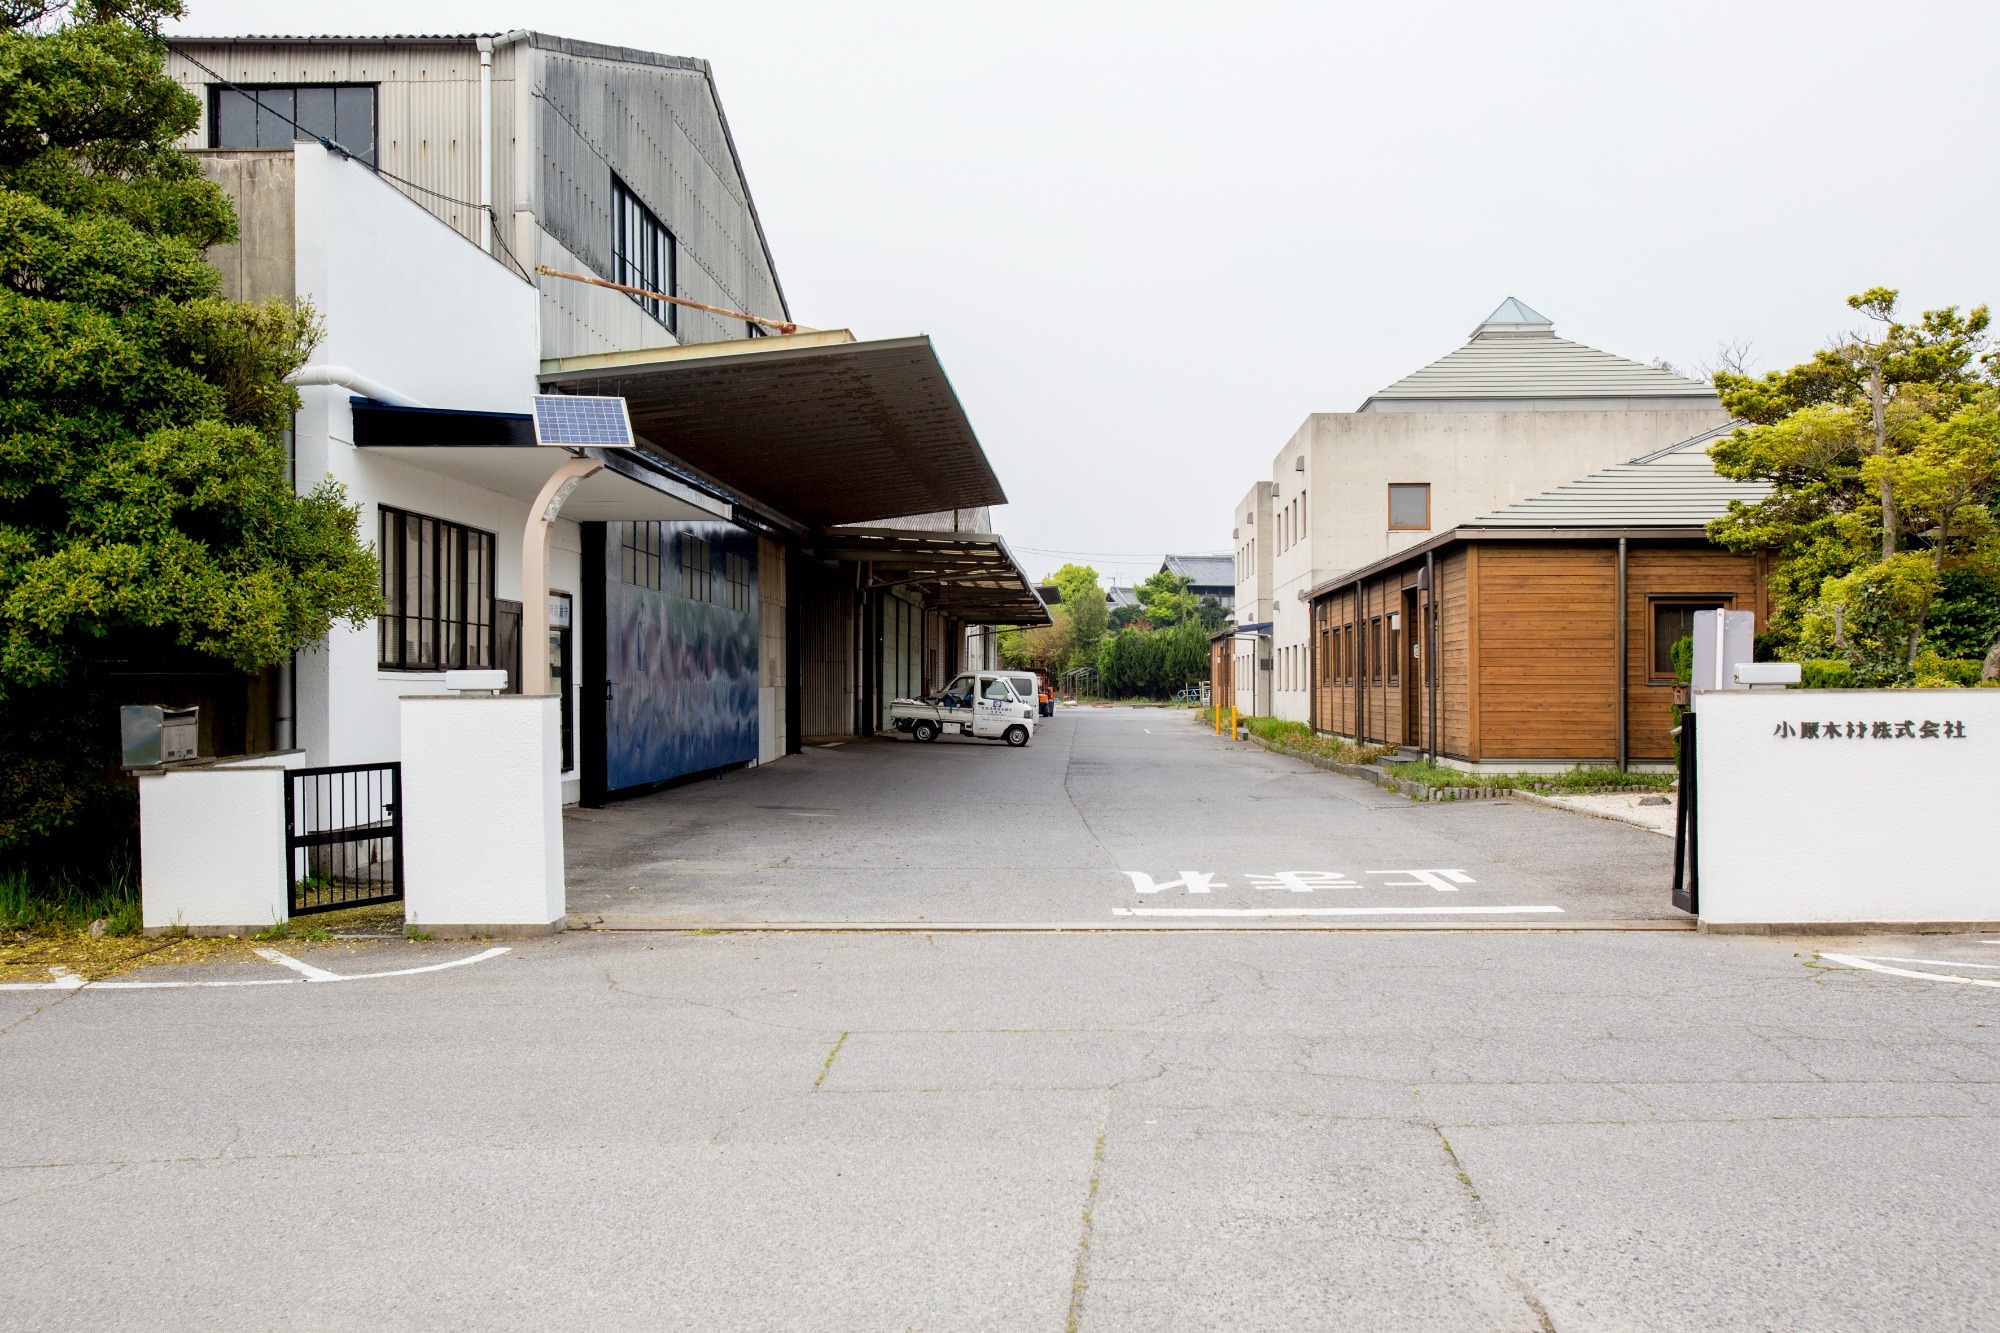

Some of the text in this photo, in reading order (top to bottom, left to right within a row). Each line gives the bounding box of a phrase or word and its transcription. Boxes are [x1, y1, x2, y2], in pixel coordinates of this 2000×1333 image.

[1773, 719, 1967, 739] 小原木材株式会社
[1121, 869, 1478, 893] 止まれ
